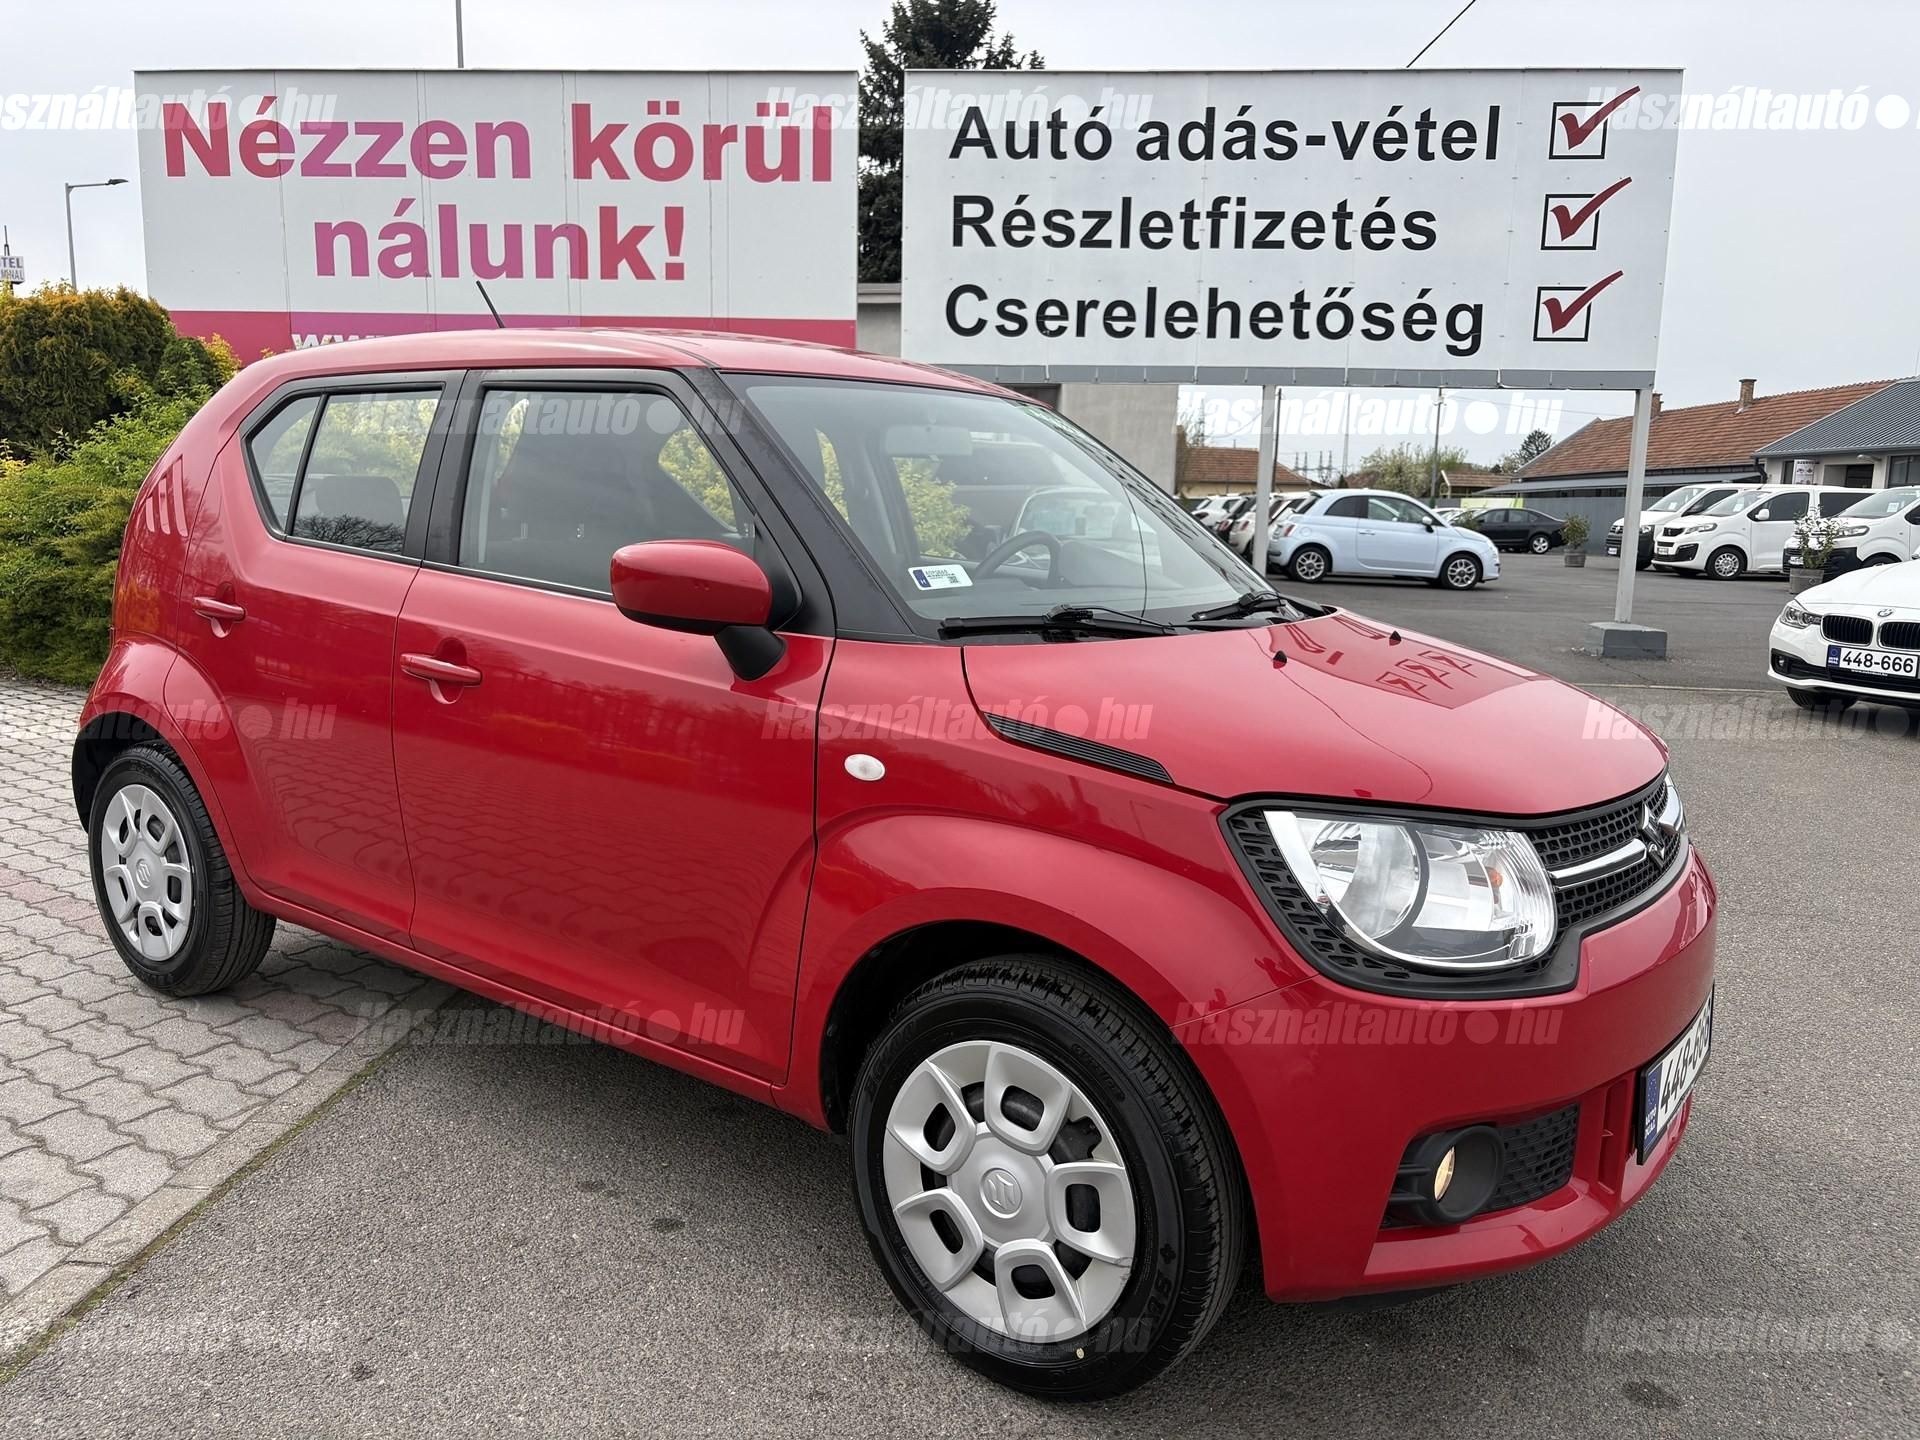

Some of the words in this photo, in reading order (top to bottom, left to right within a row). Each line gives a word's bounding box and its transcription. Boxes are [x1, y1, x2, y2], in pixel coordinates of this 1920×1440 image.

[164, 96, 531, 180] Nézzen
[571, 100, 832, 183] körül
[949, 106, 1112, 161] Autó
[1136, 105, 1501, 162] adás-vétel
[314, 198, 685, 281] nálunk!
[953, 194, 1437, 251] Részletfizetés
[0, 257, 23, 269] TEL
[945, 284, 1483, 357] Cserelehetőség
[1842, 651, 1914, 673] 448-666
